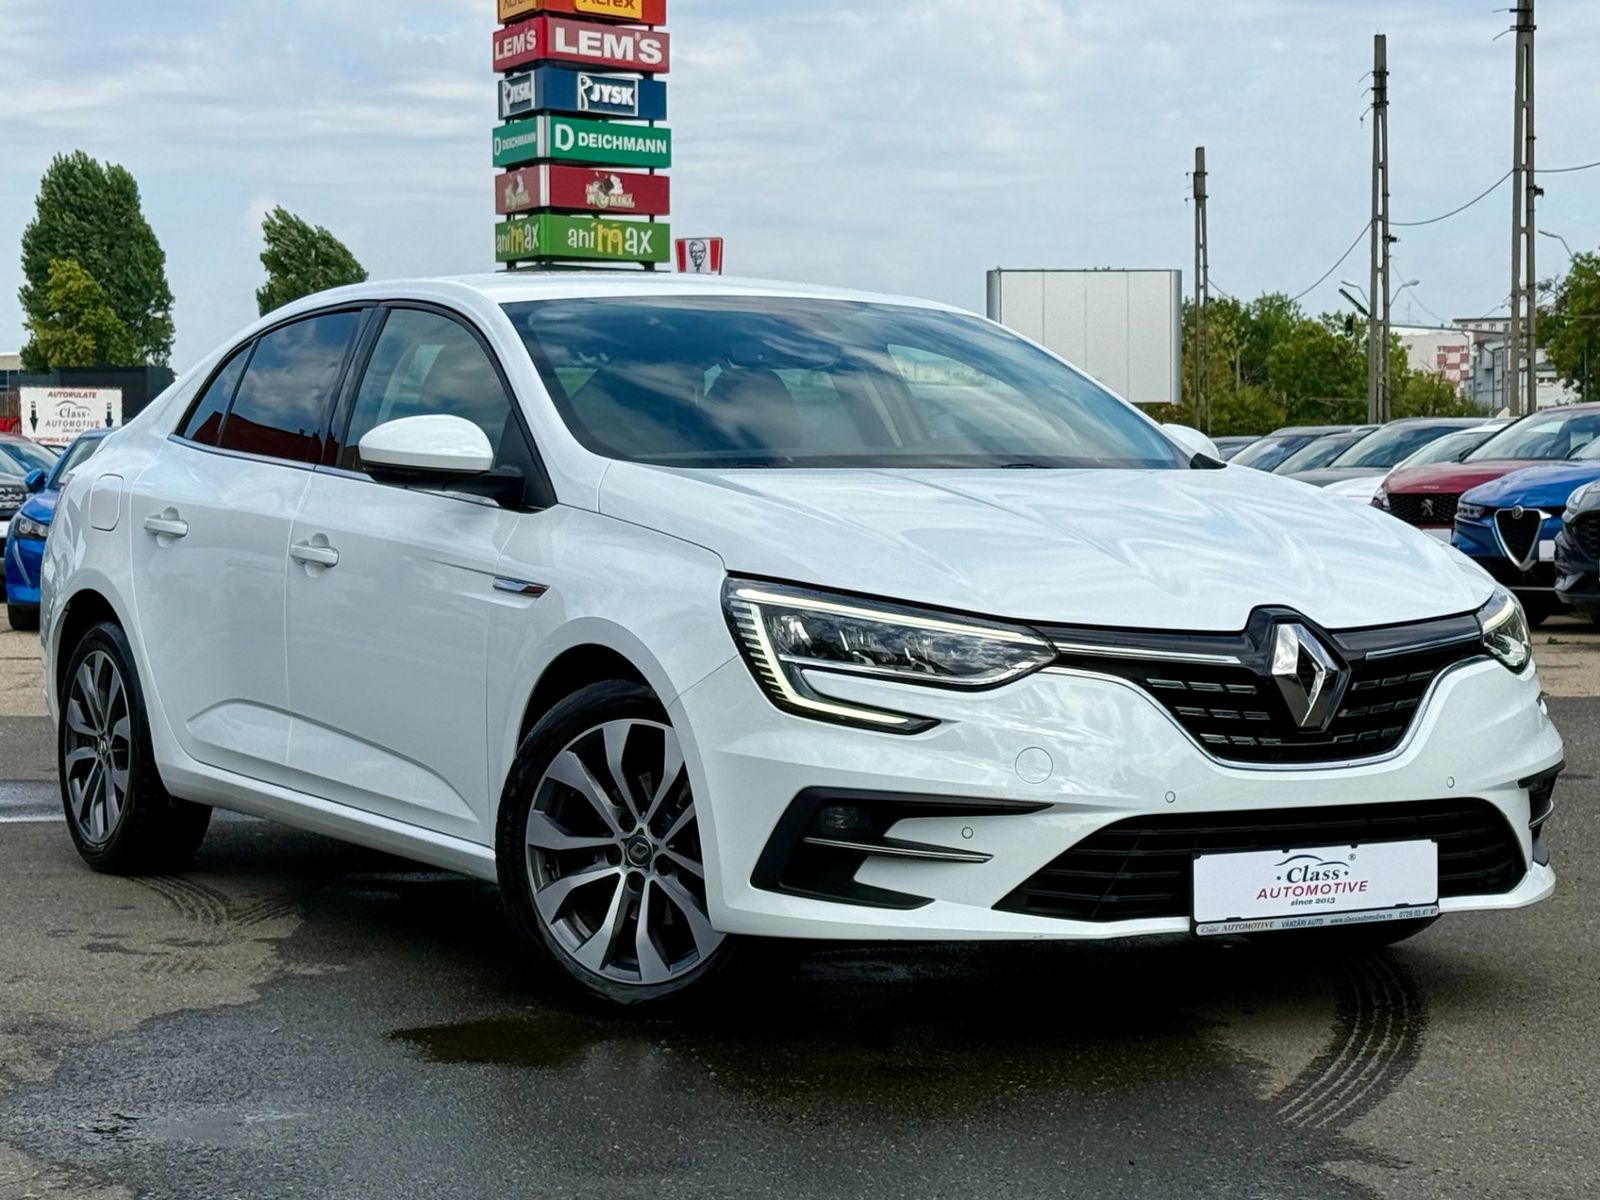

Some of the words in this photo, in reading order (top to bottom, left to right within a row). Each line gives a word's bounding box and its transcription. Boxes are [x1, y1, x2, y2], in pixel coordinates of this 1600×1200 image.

[495, 28, 537, 61] LEM'S
[555, 27, 663, 65] LEM'S
[590, 84, 634, 106] JYSK
[555, 123, 574, 151] D
[578, 131, 667, 155] DEICHMANN
[567, 222, 653, 256] animax
[47, 391, 97, 399] AUTORULATE
[58, 407, 87, 418] Class
[45, 419, 100, 428] AUTOMOTIVE
[1286, 864, 1340, 884] Class
[1256, 880, 1368, 900] AUTOMOTIVE
[1290, 898, 1313, 906] since
[1314, 897, 1336, 905] 2013
[1222, 921, 1275, 932] AUTOMOTIVE
[1307, 918, 1324, 927] AUTO
